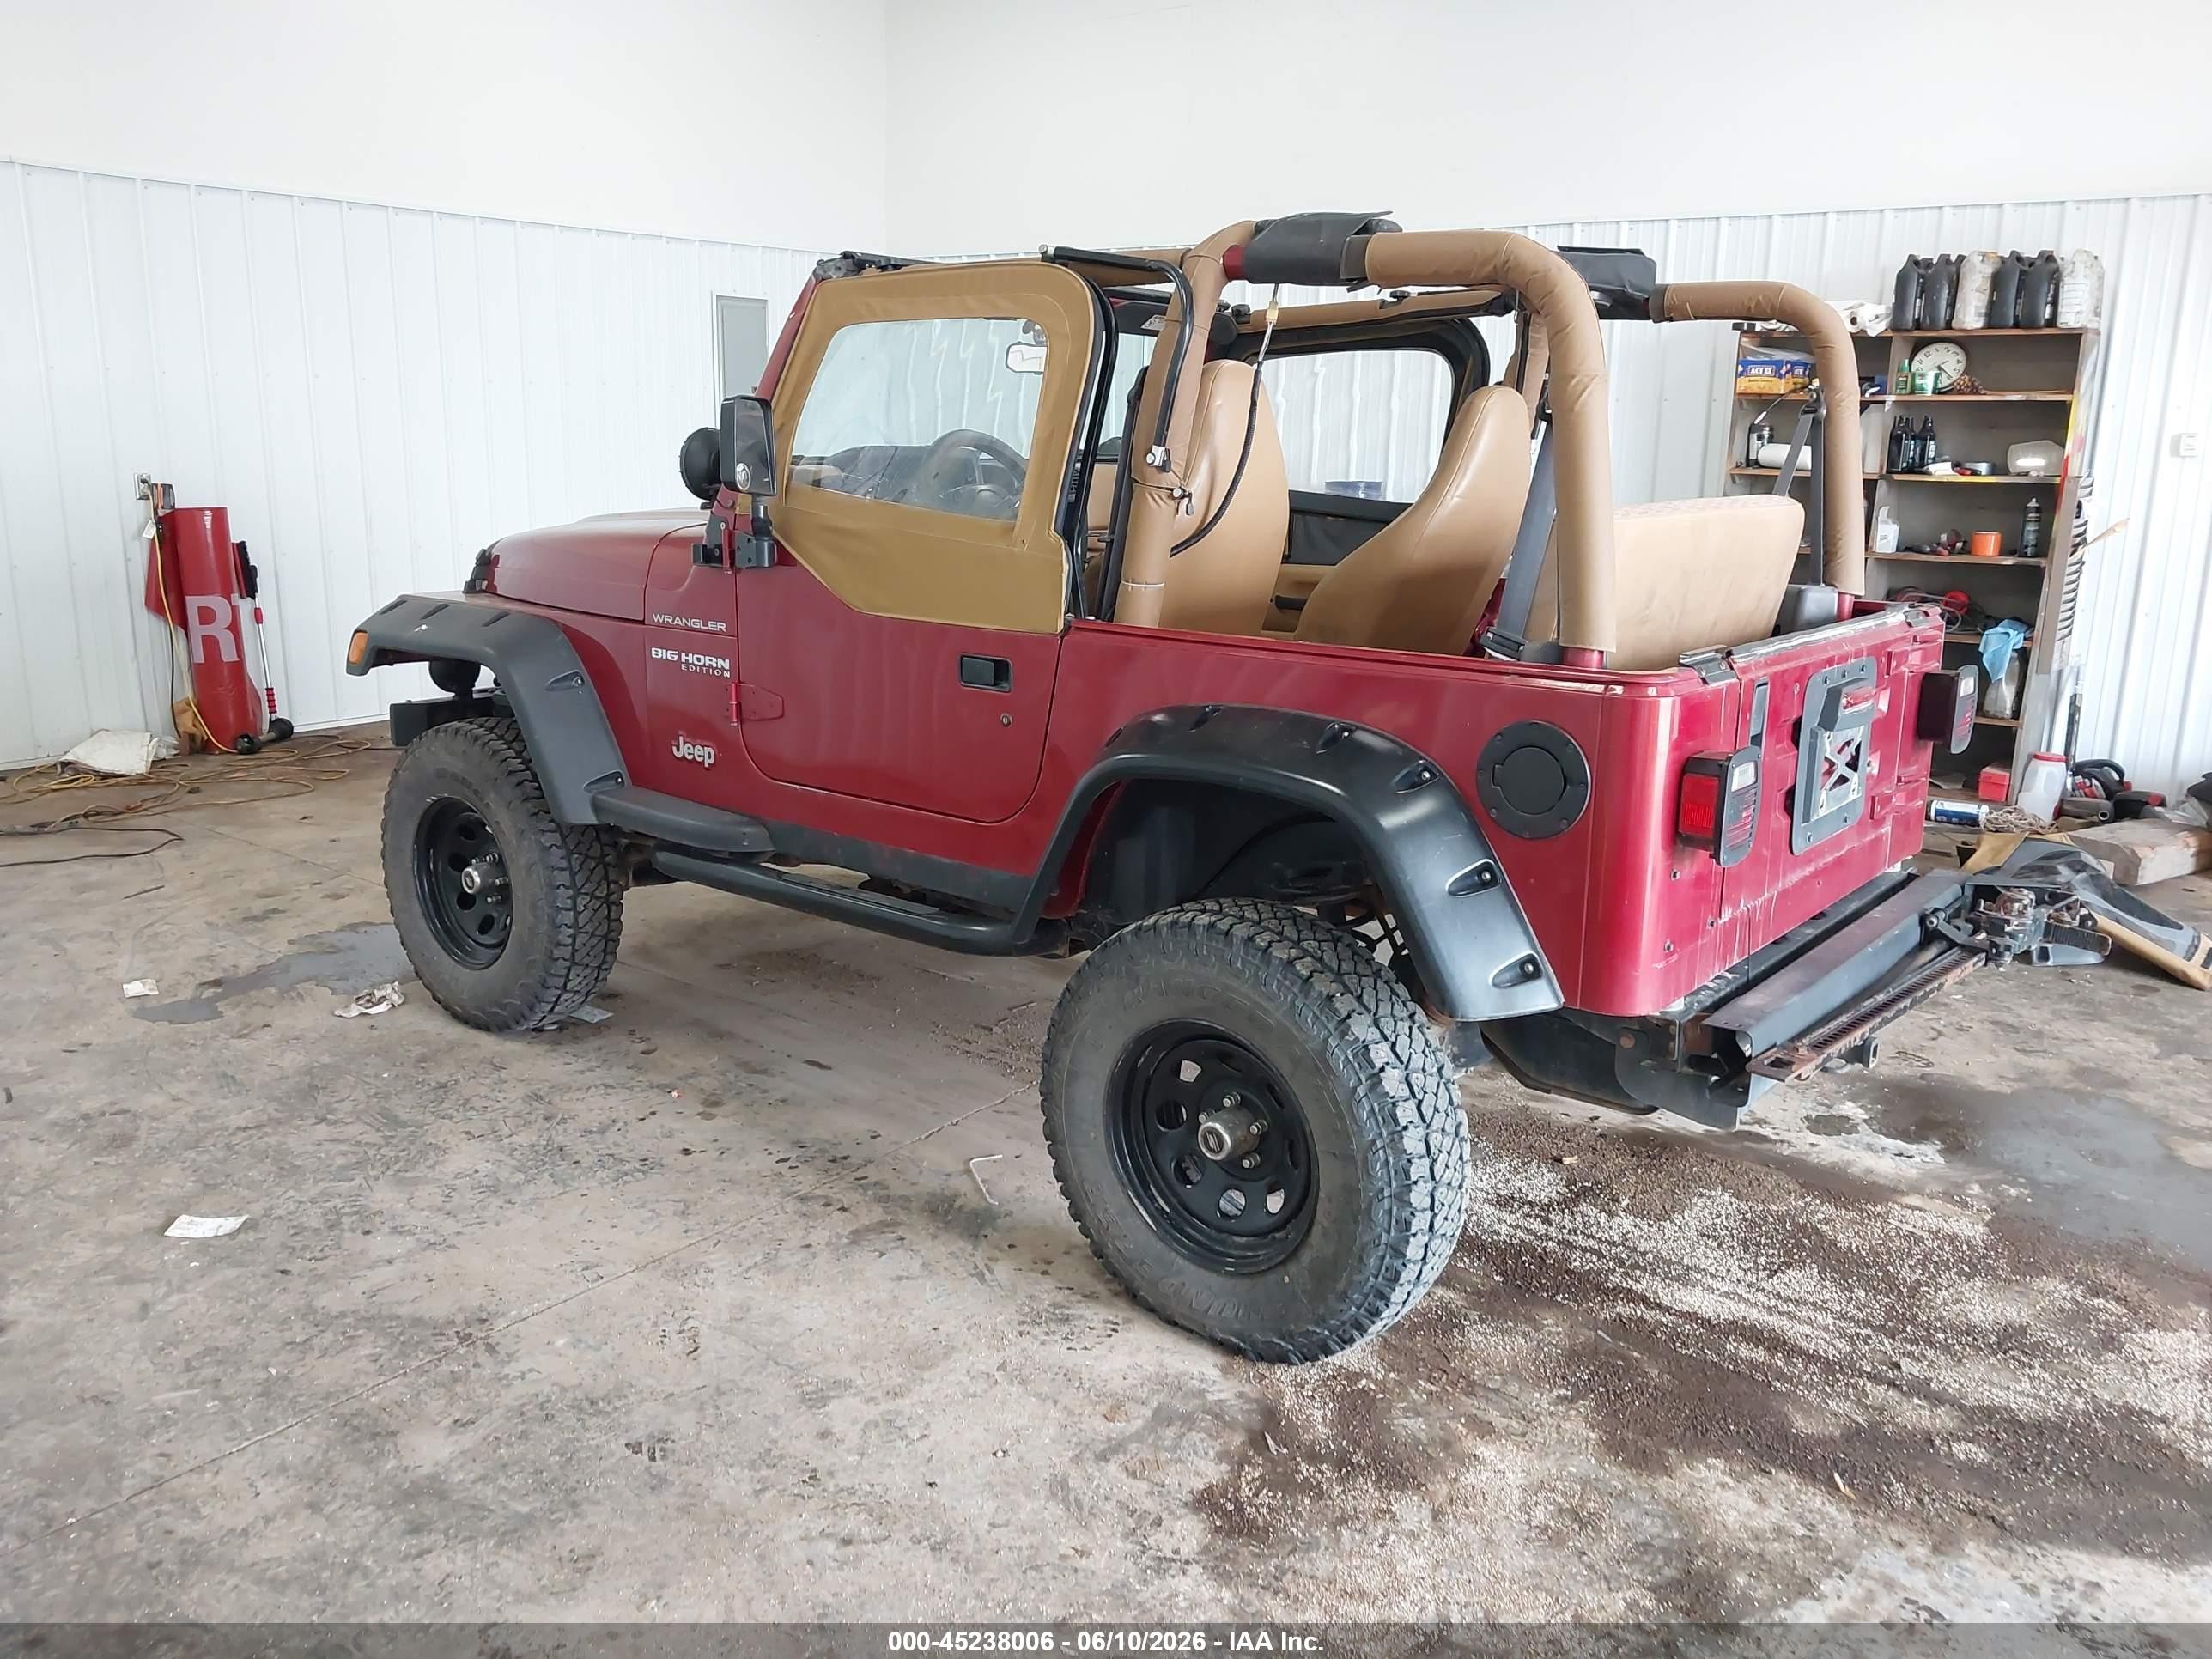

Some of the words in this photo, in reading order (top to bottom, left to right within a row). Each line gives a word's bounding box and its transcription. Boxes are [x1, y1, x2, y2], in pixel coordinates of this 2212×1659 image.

[185, 592, 240, 664] R
[653, 612, 726, 632] WRANGLER
[651, 647, 678, 661] BIG
[681, 652, 730, 670] HORN
[681, 664, 730, 678] EDITION
[672, 735, 715, 768] Jeep
